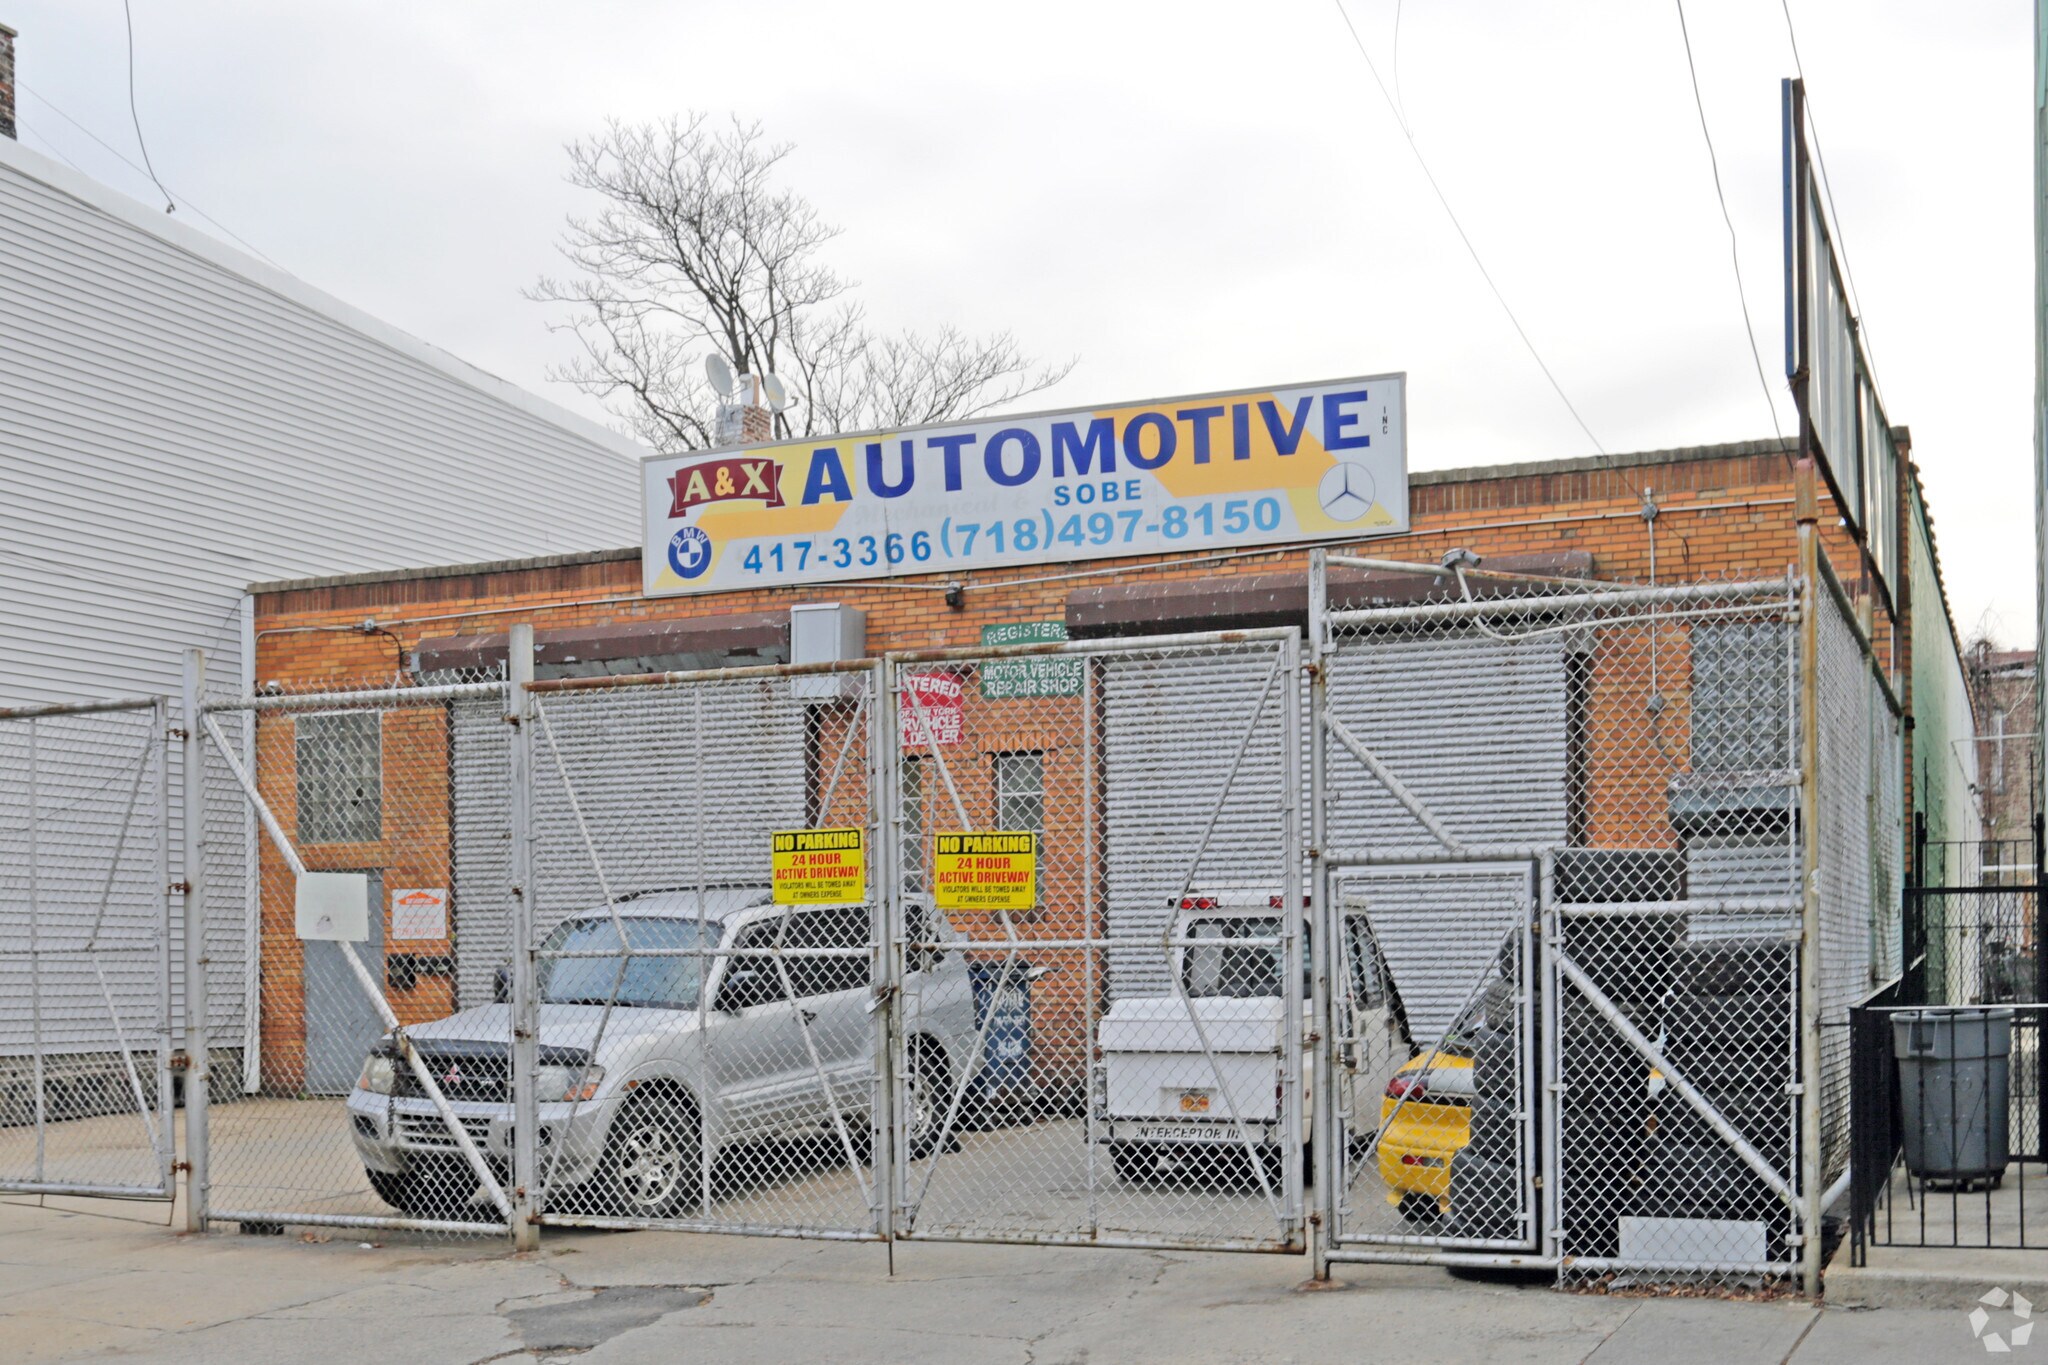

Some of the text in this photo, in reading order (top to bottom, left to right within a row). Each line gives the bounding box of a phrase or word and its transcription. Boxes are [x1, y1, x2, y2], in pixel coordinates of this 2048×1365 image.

[801, 390, 1370, 505] AUTOMOTIVE
[1054, 479, 1142, 506] SOBE
[671, 527, 709, 548] BMW
[743, 530, 931, 574] 417-3366
[984, 662, 1082, 680] MOTOR VEHICLE
[986, 678, 1079, 695] REPAIR SHOP
[932, 707, 957, 716] YORK
[910, 729, 958, 745] DELER
[776, 832, 858, 851] NO PARKING
[939, 835, 1030, 853] NO PARKING
[792, 853, 841, 866] 24 HOUR
[957, 857, 1011, 869] 24 HOUR
[776, 866, 859, 880] ACTIVE DRIVEWAY
[939, 871, 1030, 883] ACTIVE DRIVEWAY
[1135, 1127, 1221, 1139] INTERCEPTOR
